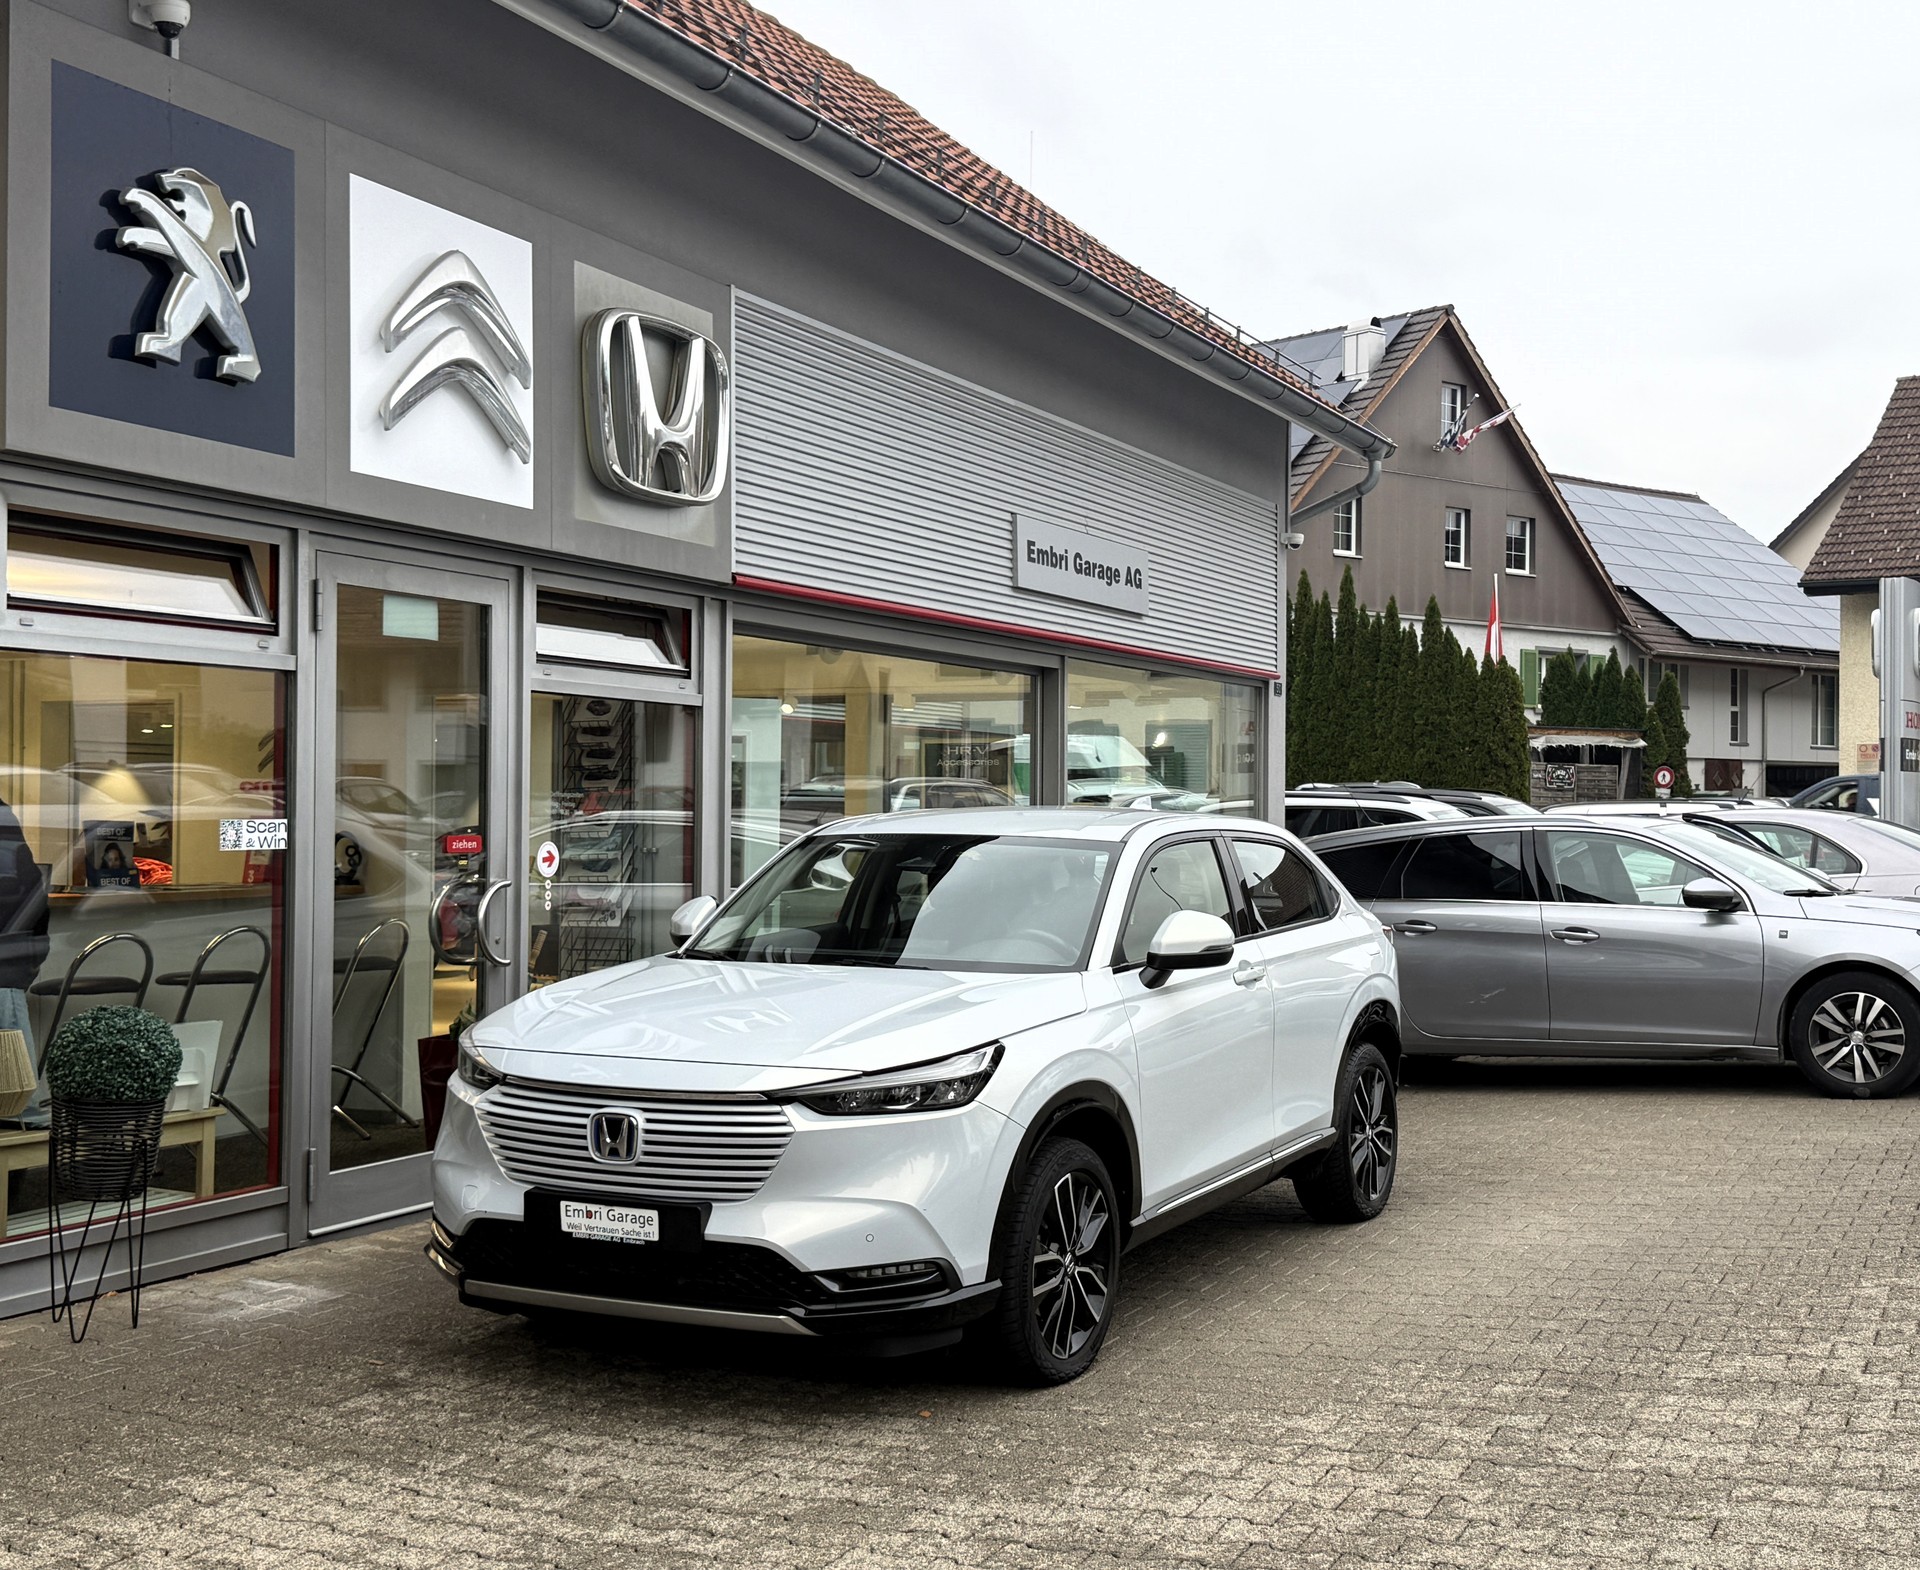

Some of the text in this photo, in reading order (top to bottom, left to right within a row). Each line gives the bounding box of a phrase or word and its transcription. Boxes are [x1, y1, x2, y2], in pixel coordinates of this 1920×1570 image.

[1027, 539, 1142, 589] Embri Garage AG
[1906, 712, 1920, 729] HO
[936, 758, 1000, 767] Accessories
[96, 828, 127, 836] BEST OF
[246, 820, 288, 833] Scan
[245, 834, 288, 849] & Win
[452, 839, 478, 849] ziehen
[565, 1205, 654, 1229] Embri Garage
[566, 1222, 583, 1231] Weil
[584, 1223, 620, 1235] Vertrauen
[621, 1227, 642, 1238] Sache
